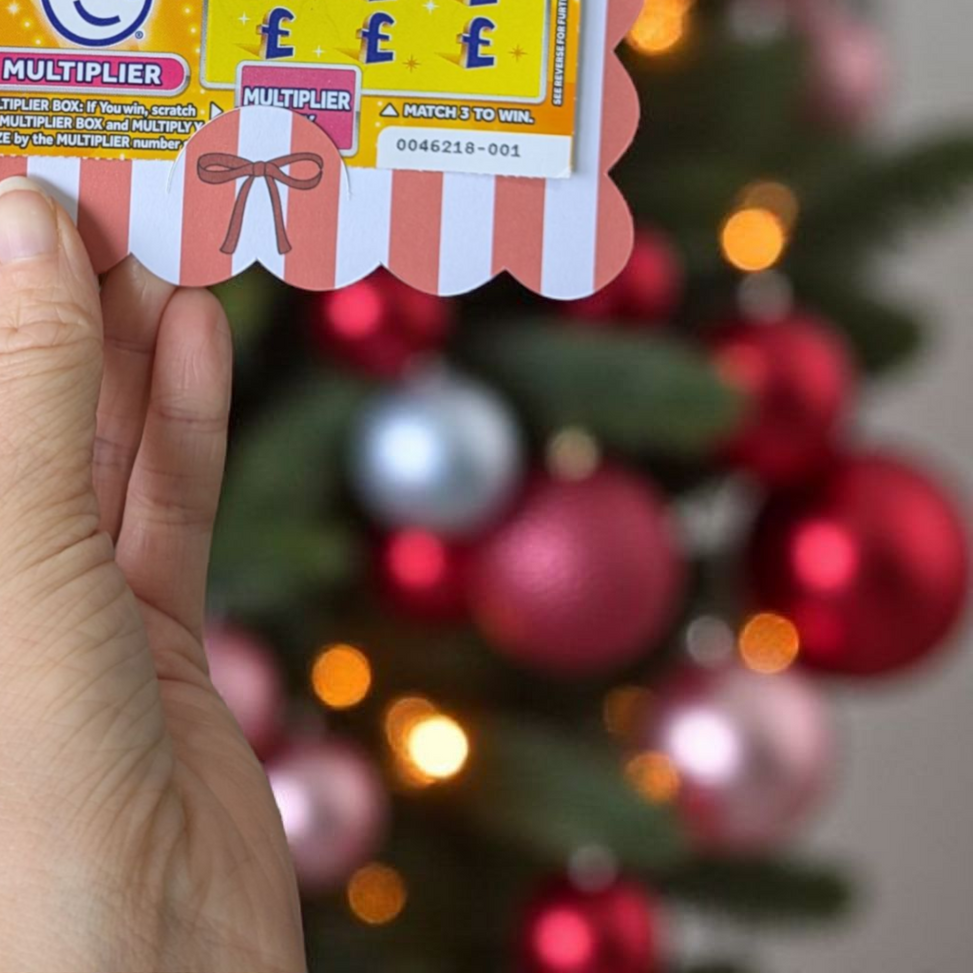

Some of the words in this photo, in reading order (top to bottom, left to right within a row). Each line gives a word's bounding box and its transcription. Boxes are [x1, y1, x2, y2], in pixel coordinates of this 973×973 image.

[256, 7, 295, 59] £
[356, 11, 395, 64] £
[457, 17, 496, 69] £
[556, 26, 566, 45] FOR
[2, 59, 163, 85] MULTIPLIER
[554, 45, 565, 87] REVERSE
[242, 87, 352, 111] MULTIPLIER
[552, 87, 563, 106] SEE
[52, 99, 84, 113] BOX:
[87, 100, 97, 113] If
[99, 101, 123, 115] You
[123, 104, 149, 117] win,
[151, 104, 196, 117] scratch
[404, 104, 459, 120] MATCH
[460, 106, 471, 120] 3
[474, 107, 496, 122] TO
[499, 108, 535, 124] WIN.
[0, 115, 74, 130] MULTIPLIER
[76, 117, 103, 130] BOX
[106, 118, 129, 131] and
[131, 120, 192, 134] MULTIPLY
[13, 132, 29, 147] by
[32, 133, 54, 145] the
[56, 134, 131, 148] MULTIPLIER
[133, 137, 181, 150] number
[395, 137, 522, 159] 0046218-001
